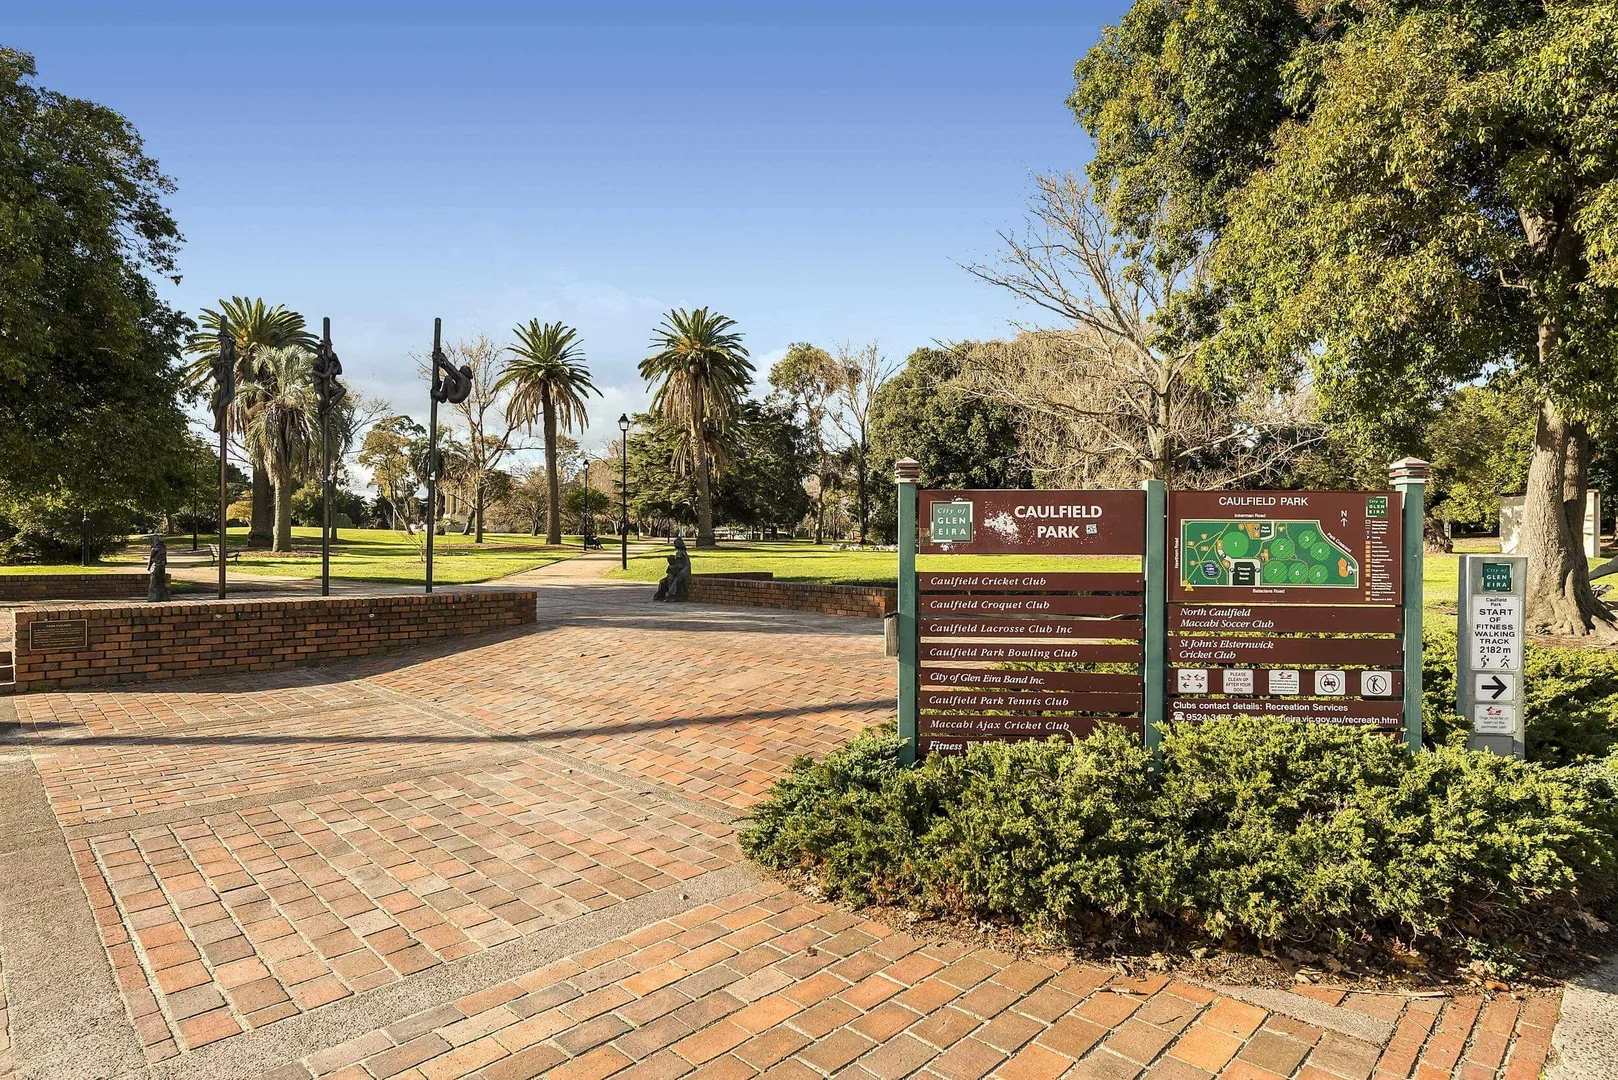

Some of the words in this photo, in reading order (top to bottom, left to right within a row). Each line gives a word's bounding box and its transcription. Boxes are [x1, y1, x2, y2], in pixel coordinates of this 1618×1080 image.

[1218, 496, 1276, 506] CAULFIELD
[1280, 496, 1309, 506] PARK
[1014, 505, 1103, 519] CAULFIELD
[1037, 526, 1080, 538] PARK
[930, 576, 978, 588] Caulfield
[981, 577, 1019, 586] Cricket
[1022, 577, 1047, 586] Club
[930, 600, 978, 611] Caulfield
[981, 601, 1022, 611] Croquet
[1025, 601, 1050, 610] Club
[1180, 608, 1207, 616] North
[1209, 608, 1251, 618] Caulfield
[930, 624, 977, 634] Caulfield
[980, 624, 1024, 633] Lacrosse
[1028, 624, 1053, 634] Club
[1055, 625, 1073, 634] Inc
[1180, 619, 1219, 628] Maccabi
[1220, 620, 1250, 628] Soccer
[1252, 620, 1274, 628] Club
[1179, 639, 1188, 648] St
[1188, 639, 1218, 650] John's
[1219, 640, 1274, 649] Elsternwick
[929, 648, 977, 658] Caulfield
[980, 648, 1004, 657] Park
[1007, 648, 1050, 659] Bowling
[1053, 649, 1078, 658] Club
[1179, 650, 1212, 659] Cricket
[1214, 650, 1236, 659] Club
[930, 672, 948, 682] City
[949, 672, 960, 683] of
[960, 673, 981, 682] Glen
[982, 674, 1001, 683] Eira
[1003, 675, 1028, 684] Band
[1029, 676, 1045, 685] Inc.
[929, 695, 977, 706] Caulfield
[980, 696, 1004, 704] Park
[1007, 696, 1041, 706] Tennis
[1044, 697, 1069, 706] Club
[1173, 702, 1196, 710] Clubs
[1198, 702, 1231, 710] contact
[1232, 702, 1262, 710] details:
[1265, 703, 1310, 711] Recreation
[1312, 703, 1348, 712] Services
[930, 720, 974, 729] Maccabi
[976, 720, 1001, 732] Ajax
[1004, 721, 1041, 730] Cricket
[1045, 721, 1070, 730] Club
[928, 740, 962, 751] Fitness
